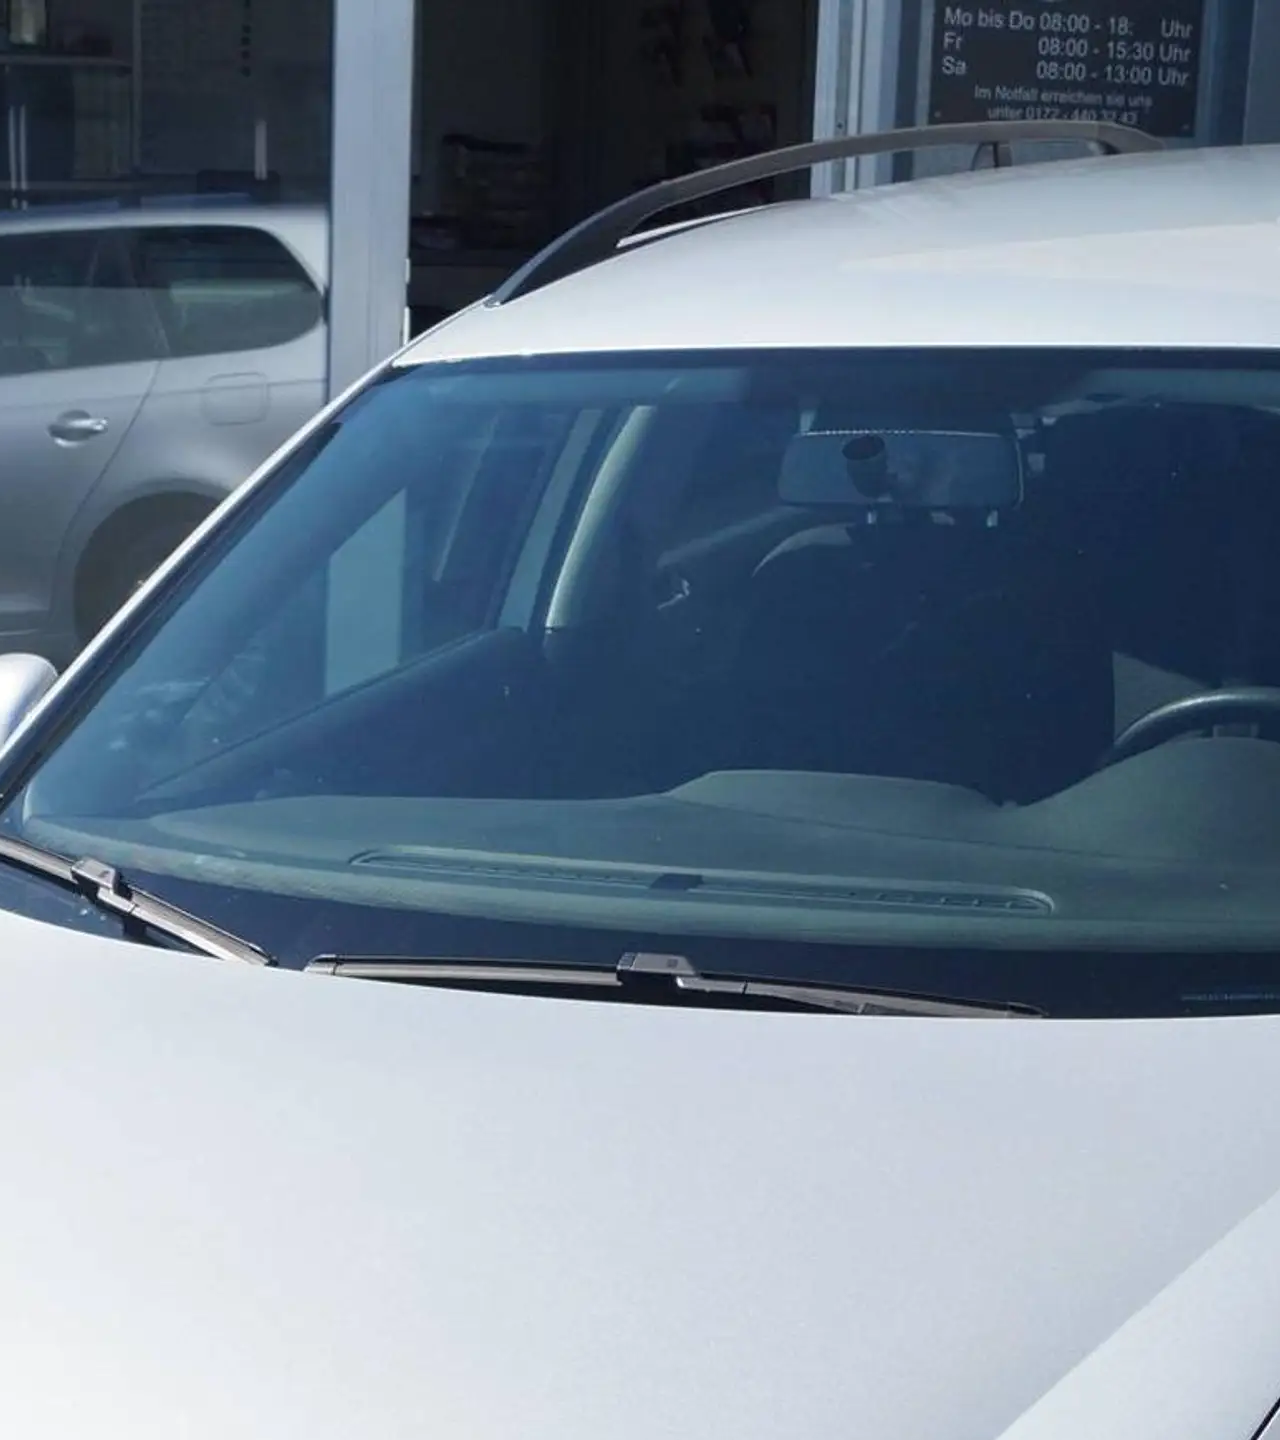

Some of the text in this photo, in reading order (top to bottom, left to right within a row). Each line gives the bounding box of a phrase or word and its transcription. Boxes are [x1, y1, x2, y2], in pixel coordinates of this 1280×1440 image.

[944, 6, 972, 27] Mo
[978, 8, 1004, 28] bis
[1009, 10, 1035, 30] Do
[1039, 12, 1090, 33] 08:00
[1161, 18, 1193, 38] Uhr
[943, 31, 963, 50] Fr
[1038, 36, 1088, 57] 08:00
[1107, 41, 1154, 61] 15:30
[1159, 42, 1191, 62] Uhr
[942, 55, 967, 75] Sa
[1036, 60, 1086, 81] 08:00
[1105, 64, 1152, 85] 13:00
[1158, 66, 1189, 87] Uhr
[995, 85, 1038, 101] Notfall
